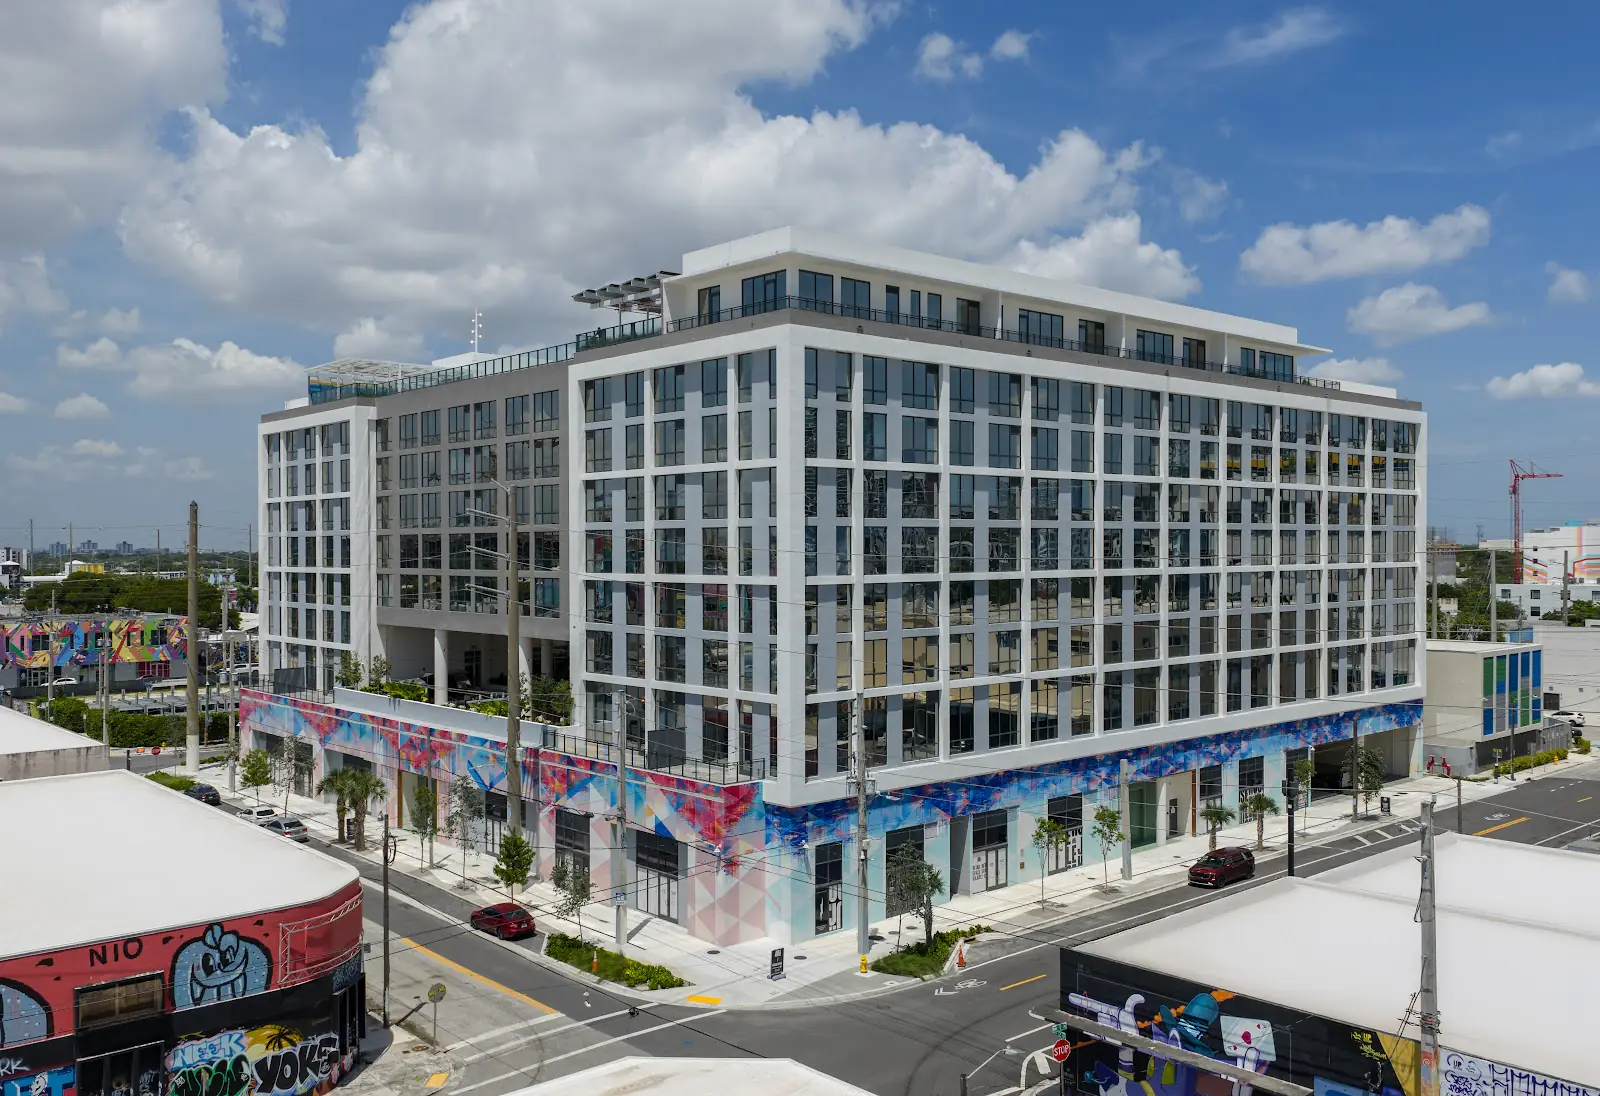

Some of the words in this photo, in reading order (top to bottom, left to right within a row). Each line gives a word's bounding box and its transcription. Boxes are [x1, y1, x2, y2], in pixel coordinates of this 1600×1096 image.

[89, 937, 143, 967] NIO
[170, 1032, 248, 1072] NEEK
[1053, 1044, 1069, 1057] STOP
